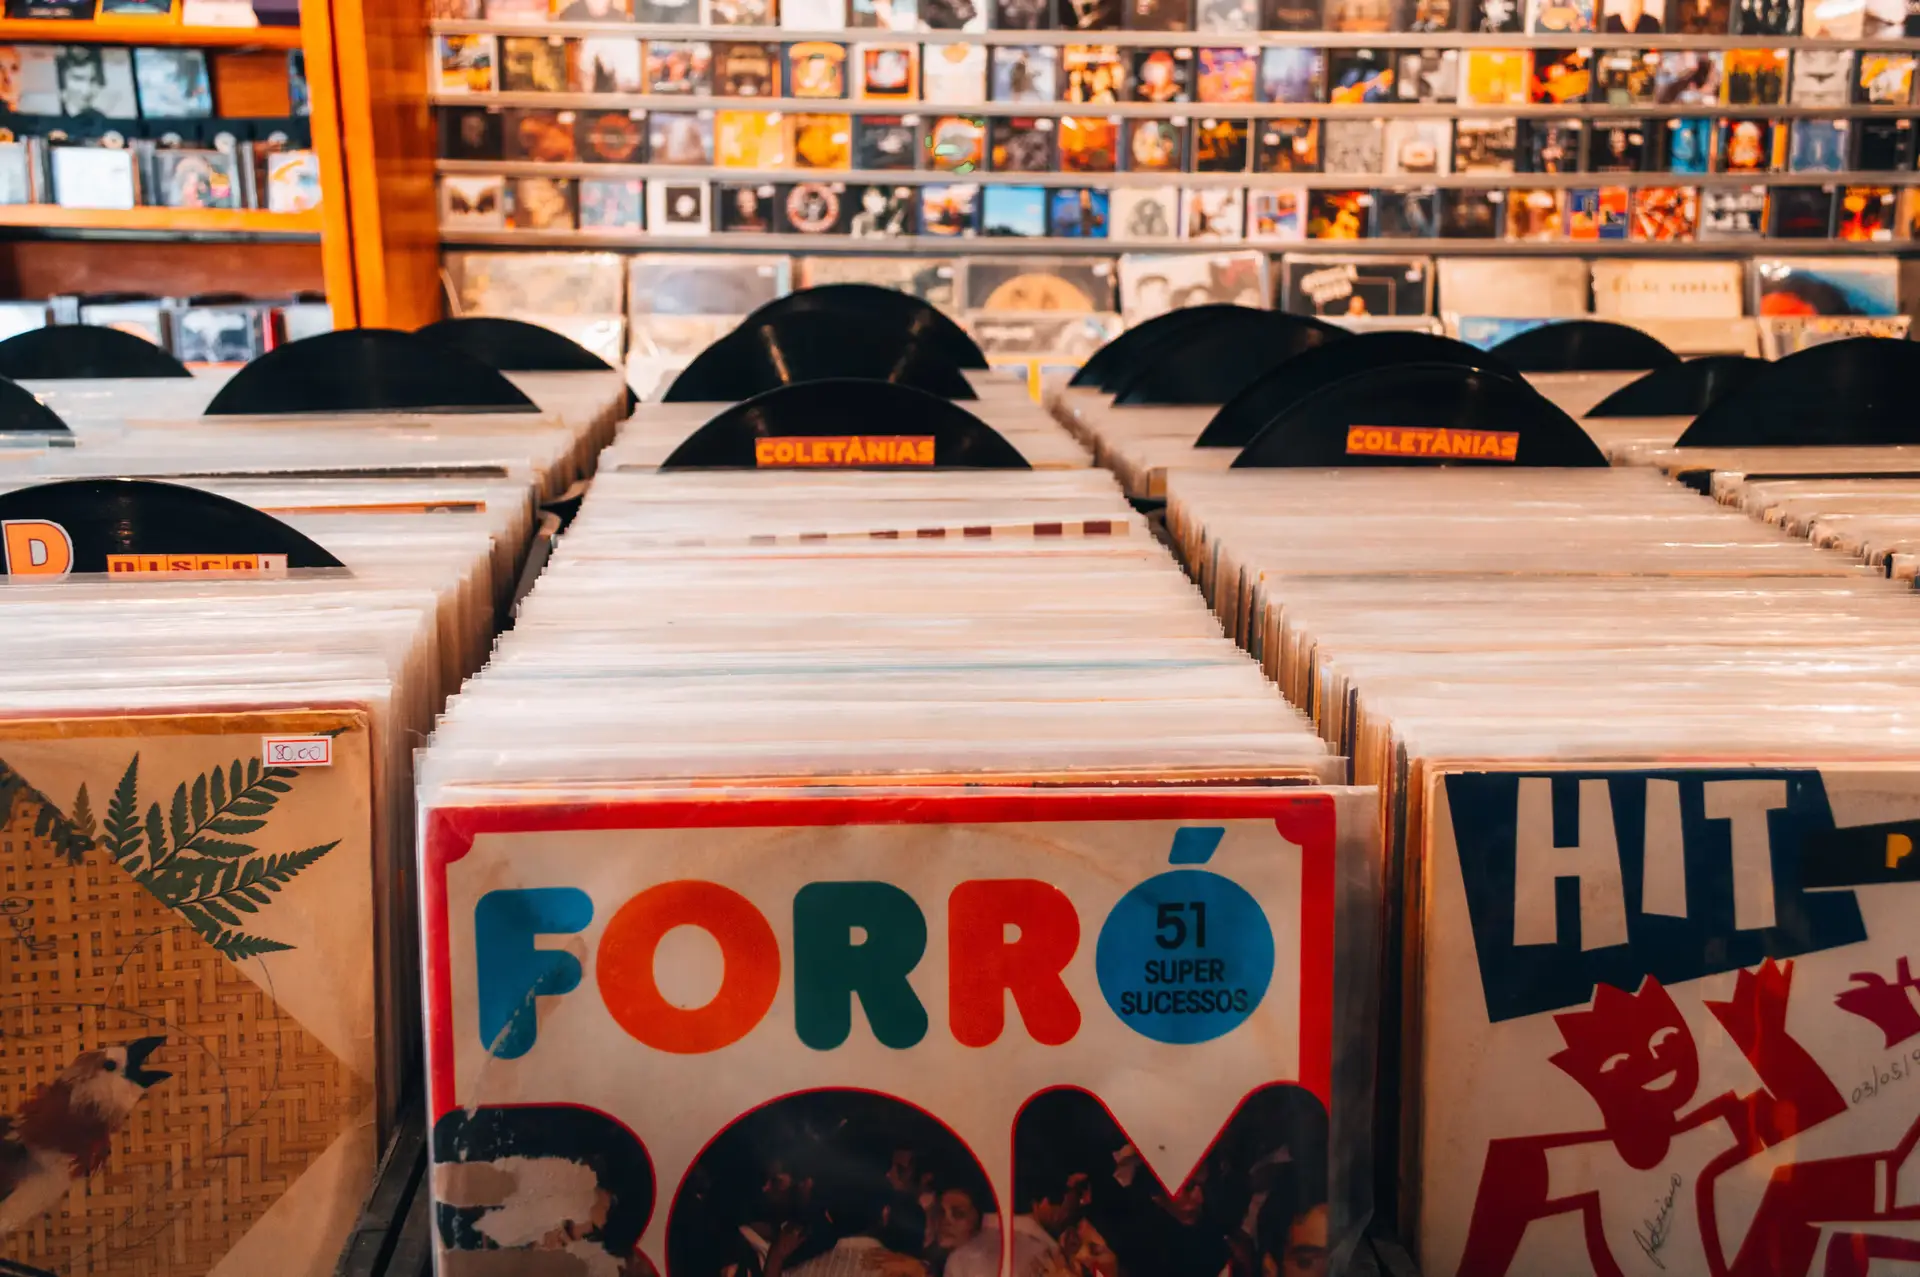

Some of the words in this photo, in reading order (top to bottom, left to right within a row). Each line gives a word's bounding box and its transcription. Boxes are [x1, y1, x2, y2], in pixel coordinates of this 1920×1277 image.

[755, 435, 935, 464] COLETÂNIAS
[1349, 427, 1519, 457] COLETÂNIAS
[2, 519, 74, 578] D
[275, 744, 321, 761] 80.00
[1513, 777, 1788, 952] HIT
[1155, 901, 1206, 950] 51
[474, 826, 1276, 1060] FORRÓ
[1144, 958, 1226, 985] SUPER
[1120, 988, 1249, 1016] SUCESSOS
